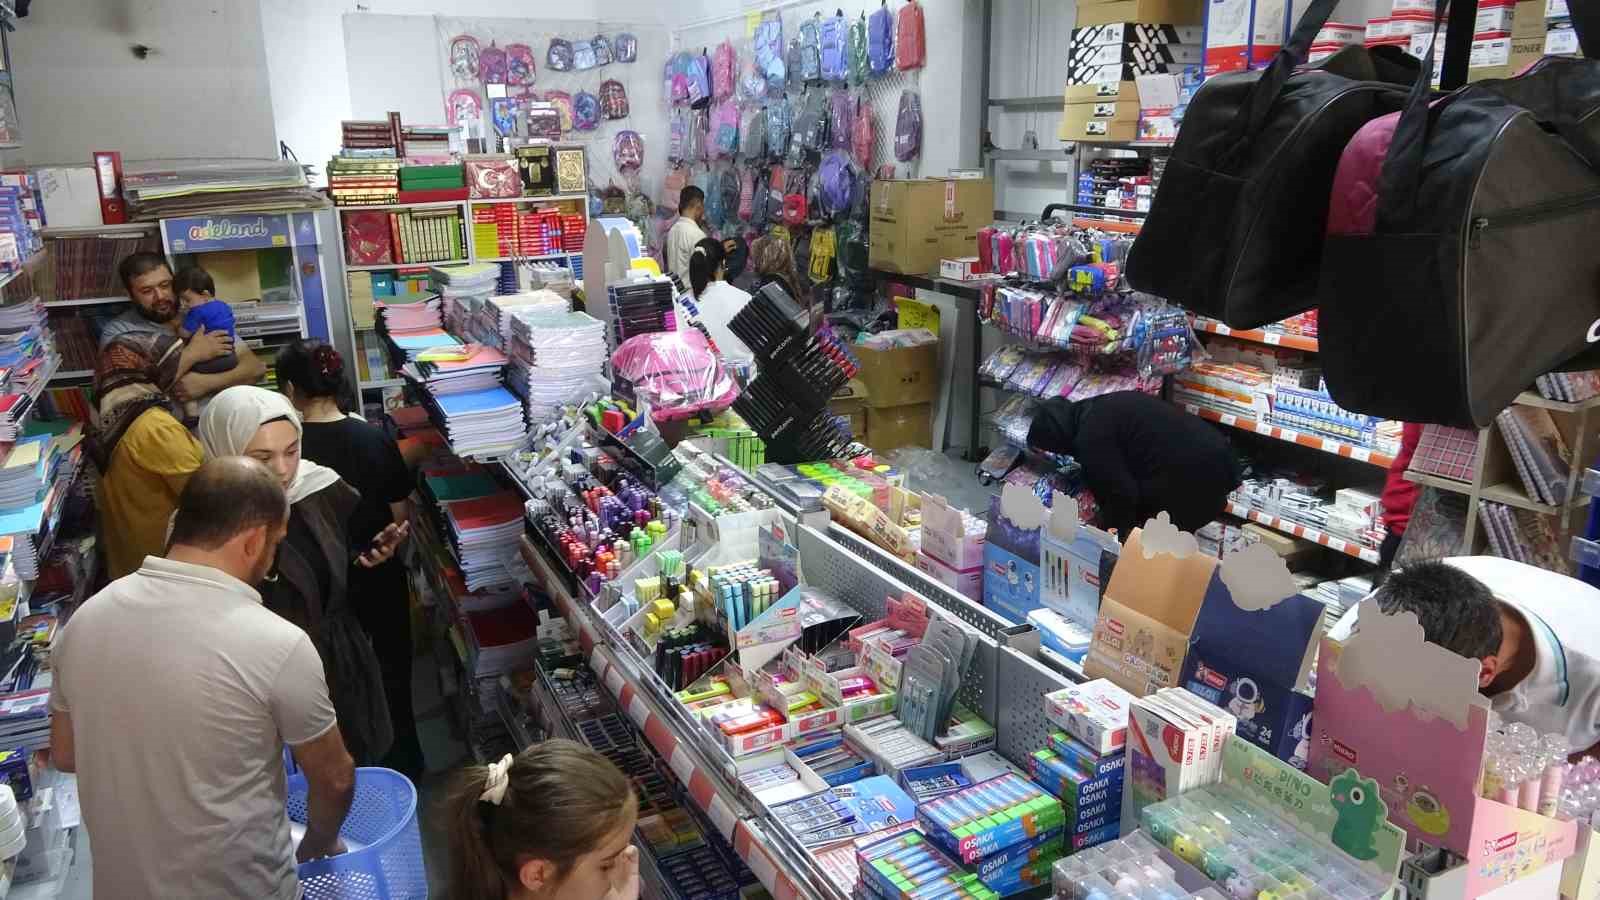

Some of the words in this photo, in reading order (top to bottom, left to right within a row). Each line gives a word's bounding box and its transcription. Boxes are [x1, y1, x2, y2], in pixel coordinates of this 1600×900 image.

[1513, 43, 1542, 54] TONER
[1259, 725, 1273, 739] 24
[1082, 778, 1109, 795] OSAKA
[1280, 769, 1312, 797] DINO
[1079, 790, 1107, 806] OSAKA
[1080, 804, 1107, 820] OSAKA
[1078, 817, 1105, 833] OSAKA
[964, 831, 995, 850] OSAKA
[1078, 831, 1105, 847] OSAKA
[969, 843, 999, 860] OSAKA
[982, 853, 1009, 875] OSAKA
